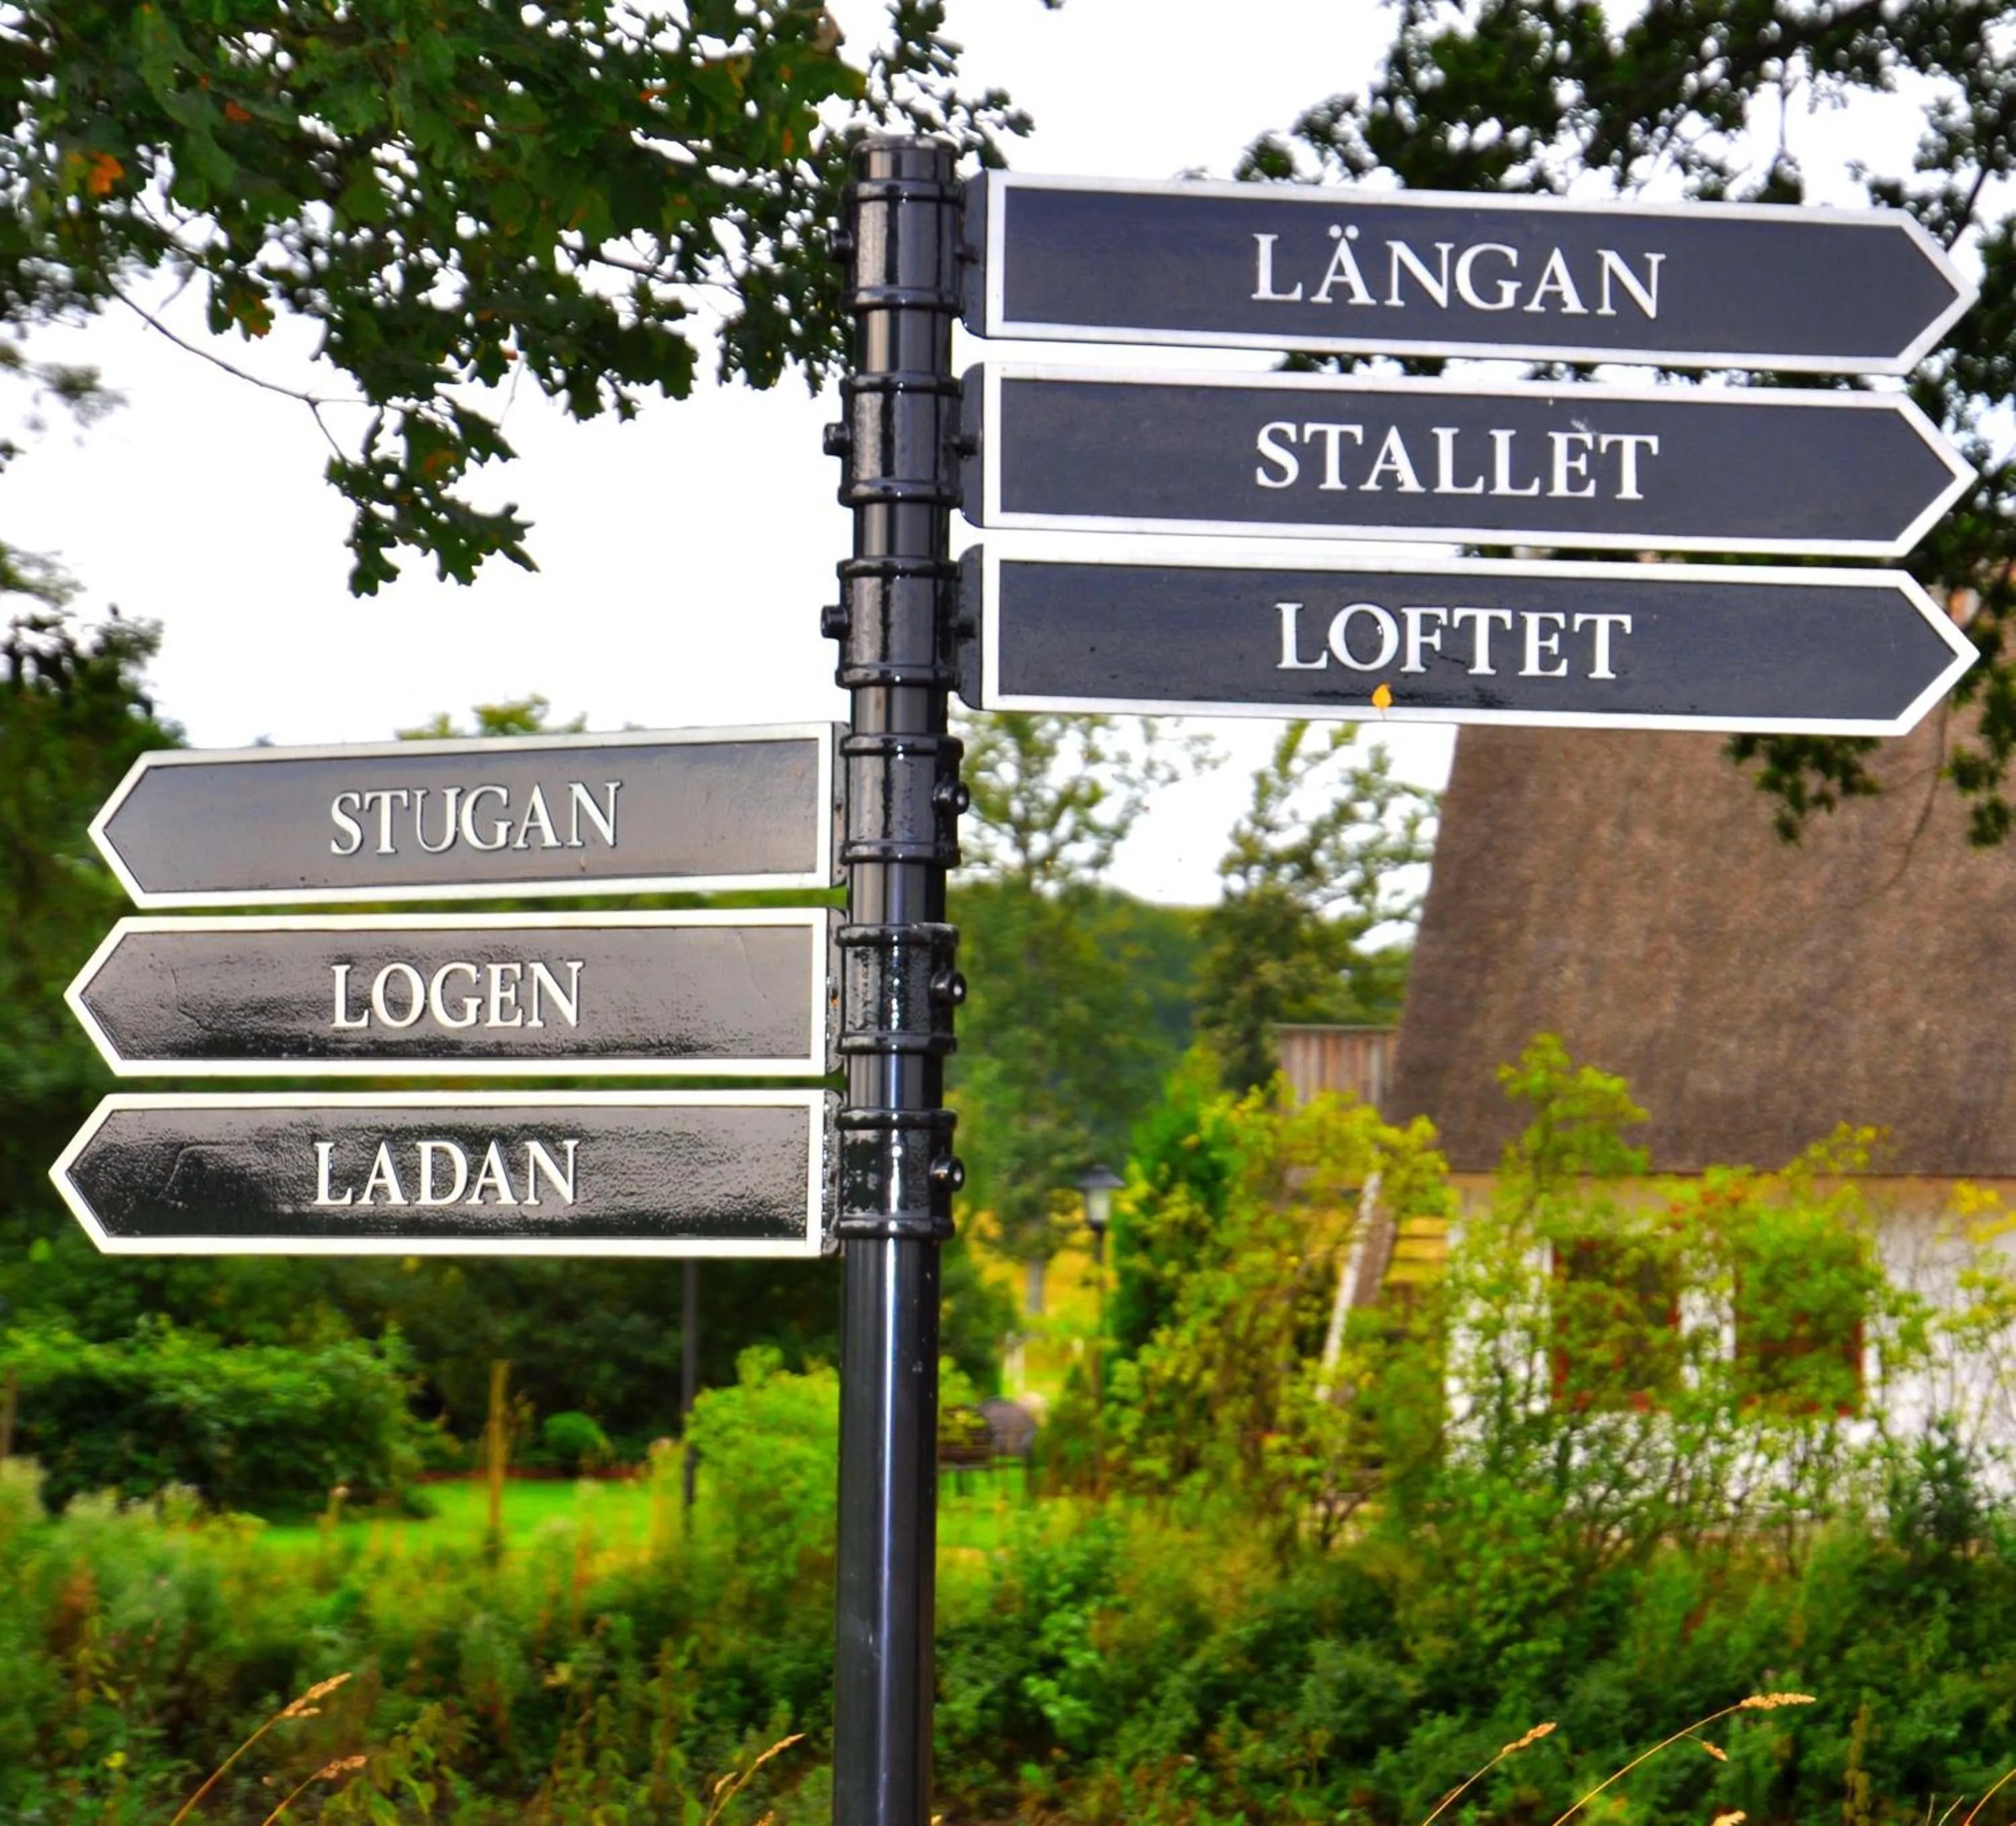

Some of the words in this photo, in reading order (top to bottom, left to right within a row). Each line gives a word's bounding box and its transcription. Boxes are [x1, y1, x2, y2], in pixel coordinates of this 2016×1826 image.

[1251, 224, 1666, 318] LÄNGAN
[1255, 421, 1660, 500] STALLET
[1275, 602, 1633, 679] LOFTET
[330, 781, 620, 854] STUGAN
[331, 961, 583, 1029] LOGEN
[312, 1139, 580, 1206] LADAN
